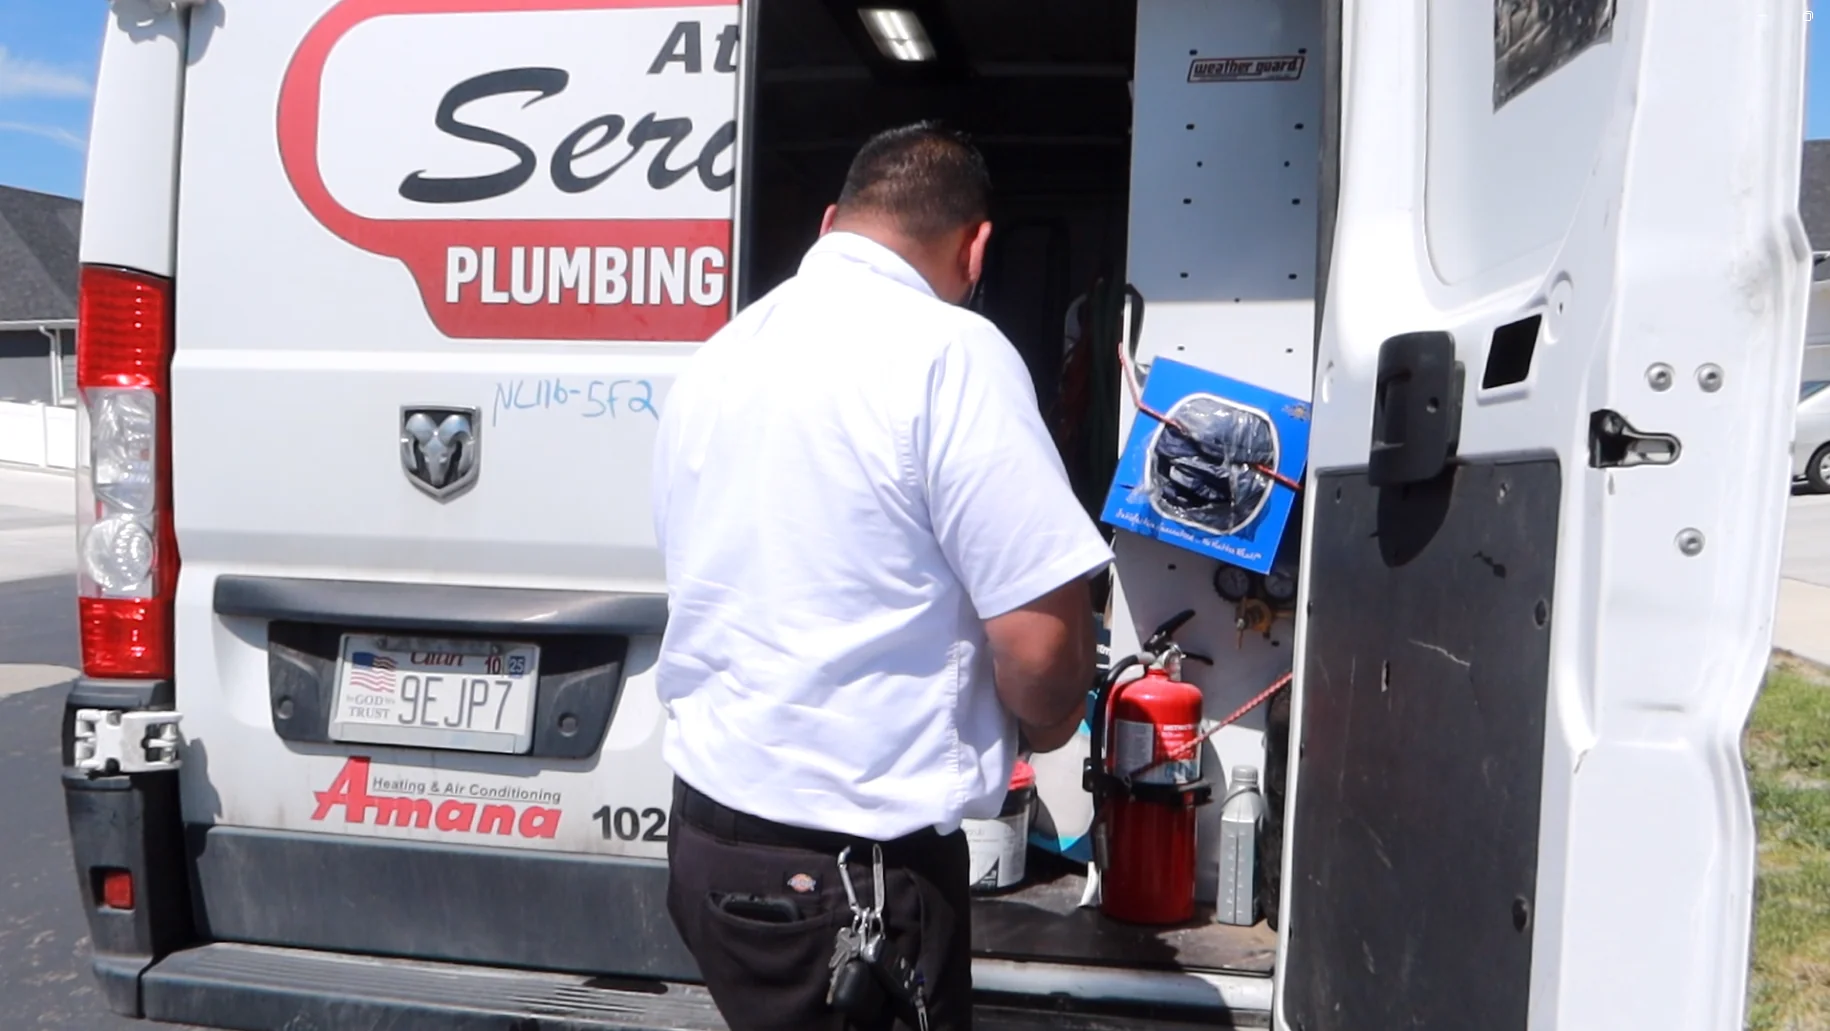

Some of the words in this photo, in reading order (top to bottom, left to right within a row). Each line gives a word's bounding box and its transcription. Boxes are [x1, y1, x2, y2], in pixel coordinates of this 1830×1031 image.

[1193, 60, 1252, 75] weather
[1256, 57, 1297, 75] guard
[445, 246, 726, 306] PLUMBING
[508, 657, 525, 674] 25
[348, 706, 391, 719] TRUST
[355, 694, 384, 706] GOD
[398, 675, 514, 730] 9EJP7
[311, 756, 562, 840] Amana
[372, 778, 426, 795] Heating
[430, 781, 440, 792] &
[444, 781, 465, 794] Air
[469, 783, 562, 804] Conditioning
[592, 805, 668, 842] 102
